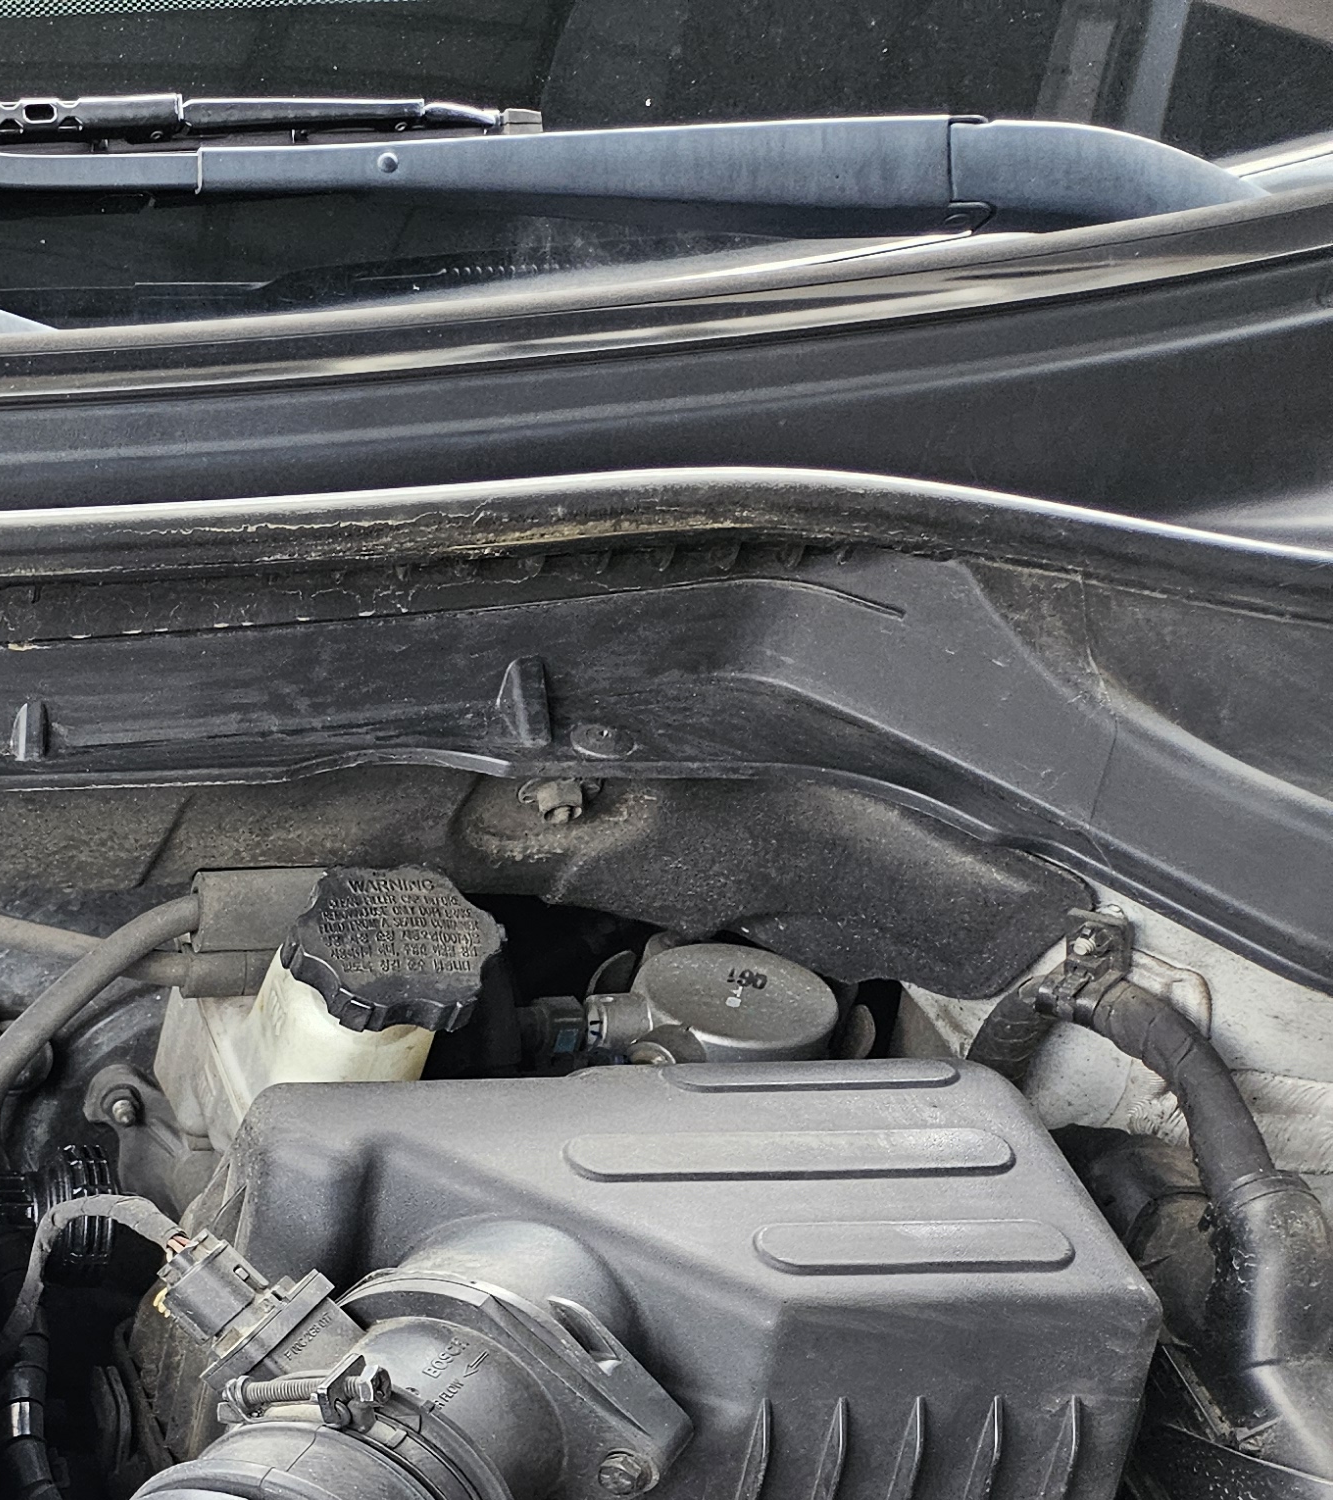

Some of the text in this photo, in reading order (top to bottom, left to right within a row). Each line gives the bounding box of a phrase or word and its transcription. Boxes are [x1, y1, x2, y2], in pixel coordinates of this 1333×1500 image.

[347, 879, 435, 893] WARNING
[422, 1336, 471, 1379] BOSCH
[438, 1378, 465, 1403] FLOW
